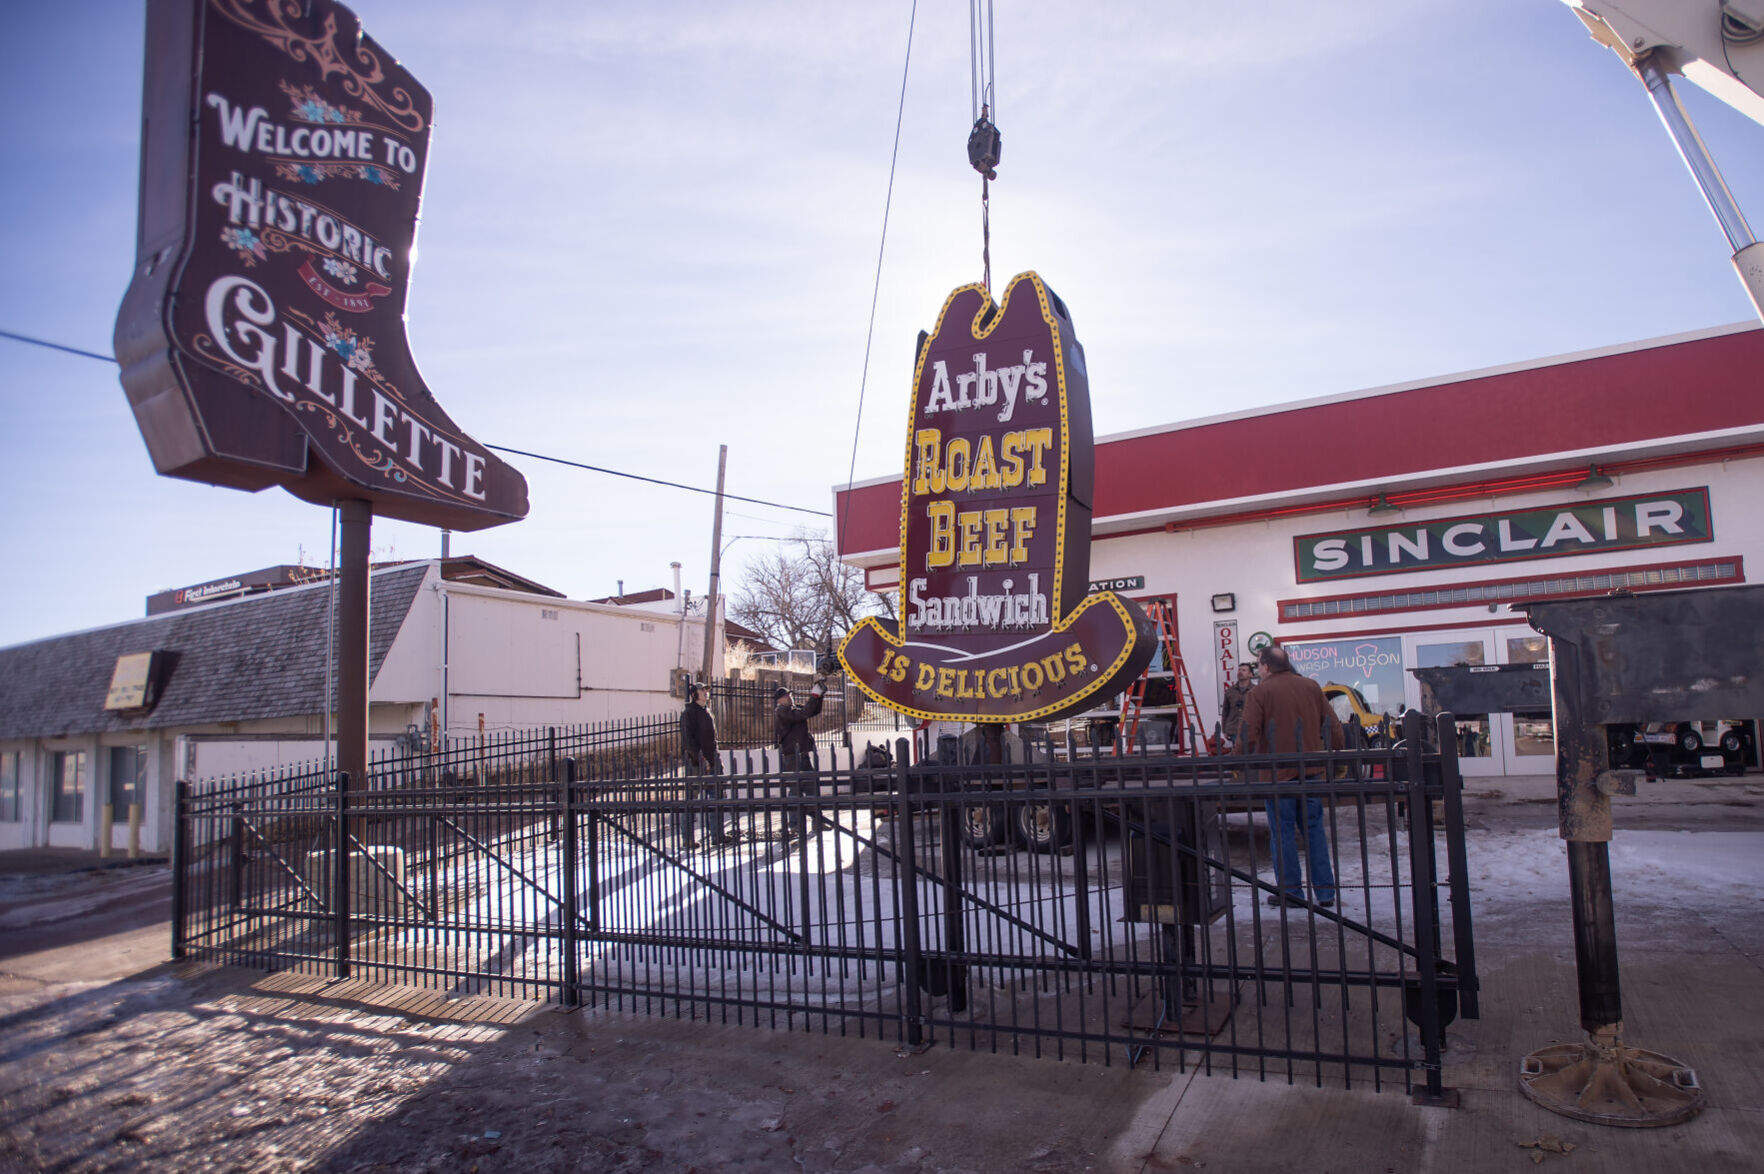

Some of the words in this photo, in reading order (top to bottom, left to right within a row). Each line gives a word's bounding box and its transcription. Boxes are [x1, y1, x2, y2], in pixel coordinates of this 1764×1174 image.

[207, 92, 372, 160] WELCOME
[383, 139, 416, 174] TO
[212, 171, 392, 281] HISTORIC
[204, 275, 487, 501] GILLETTE
[912, 428, 1053, 495] ROAST
[926, 501, 1037, 569] BEEF
[1312, 500, 1685, 572] SINCLAIR
[908, 573, 1049, 629] Sandwich
[1088, 579, 1137, 591] ATION
[877, 648, 911, 682] IS
[915, 643, 1088, 699] DELICIOUS
[1220, 627, 1235, 693] OPALIN
[1287, 646, 1338, 662] HUDSON
[1296, 660, 1330, 672] WASP
[1334, 653, 1400, 669] HUDSON
